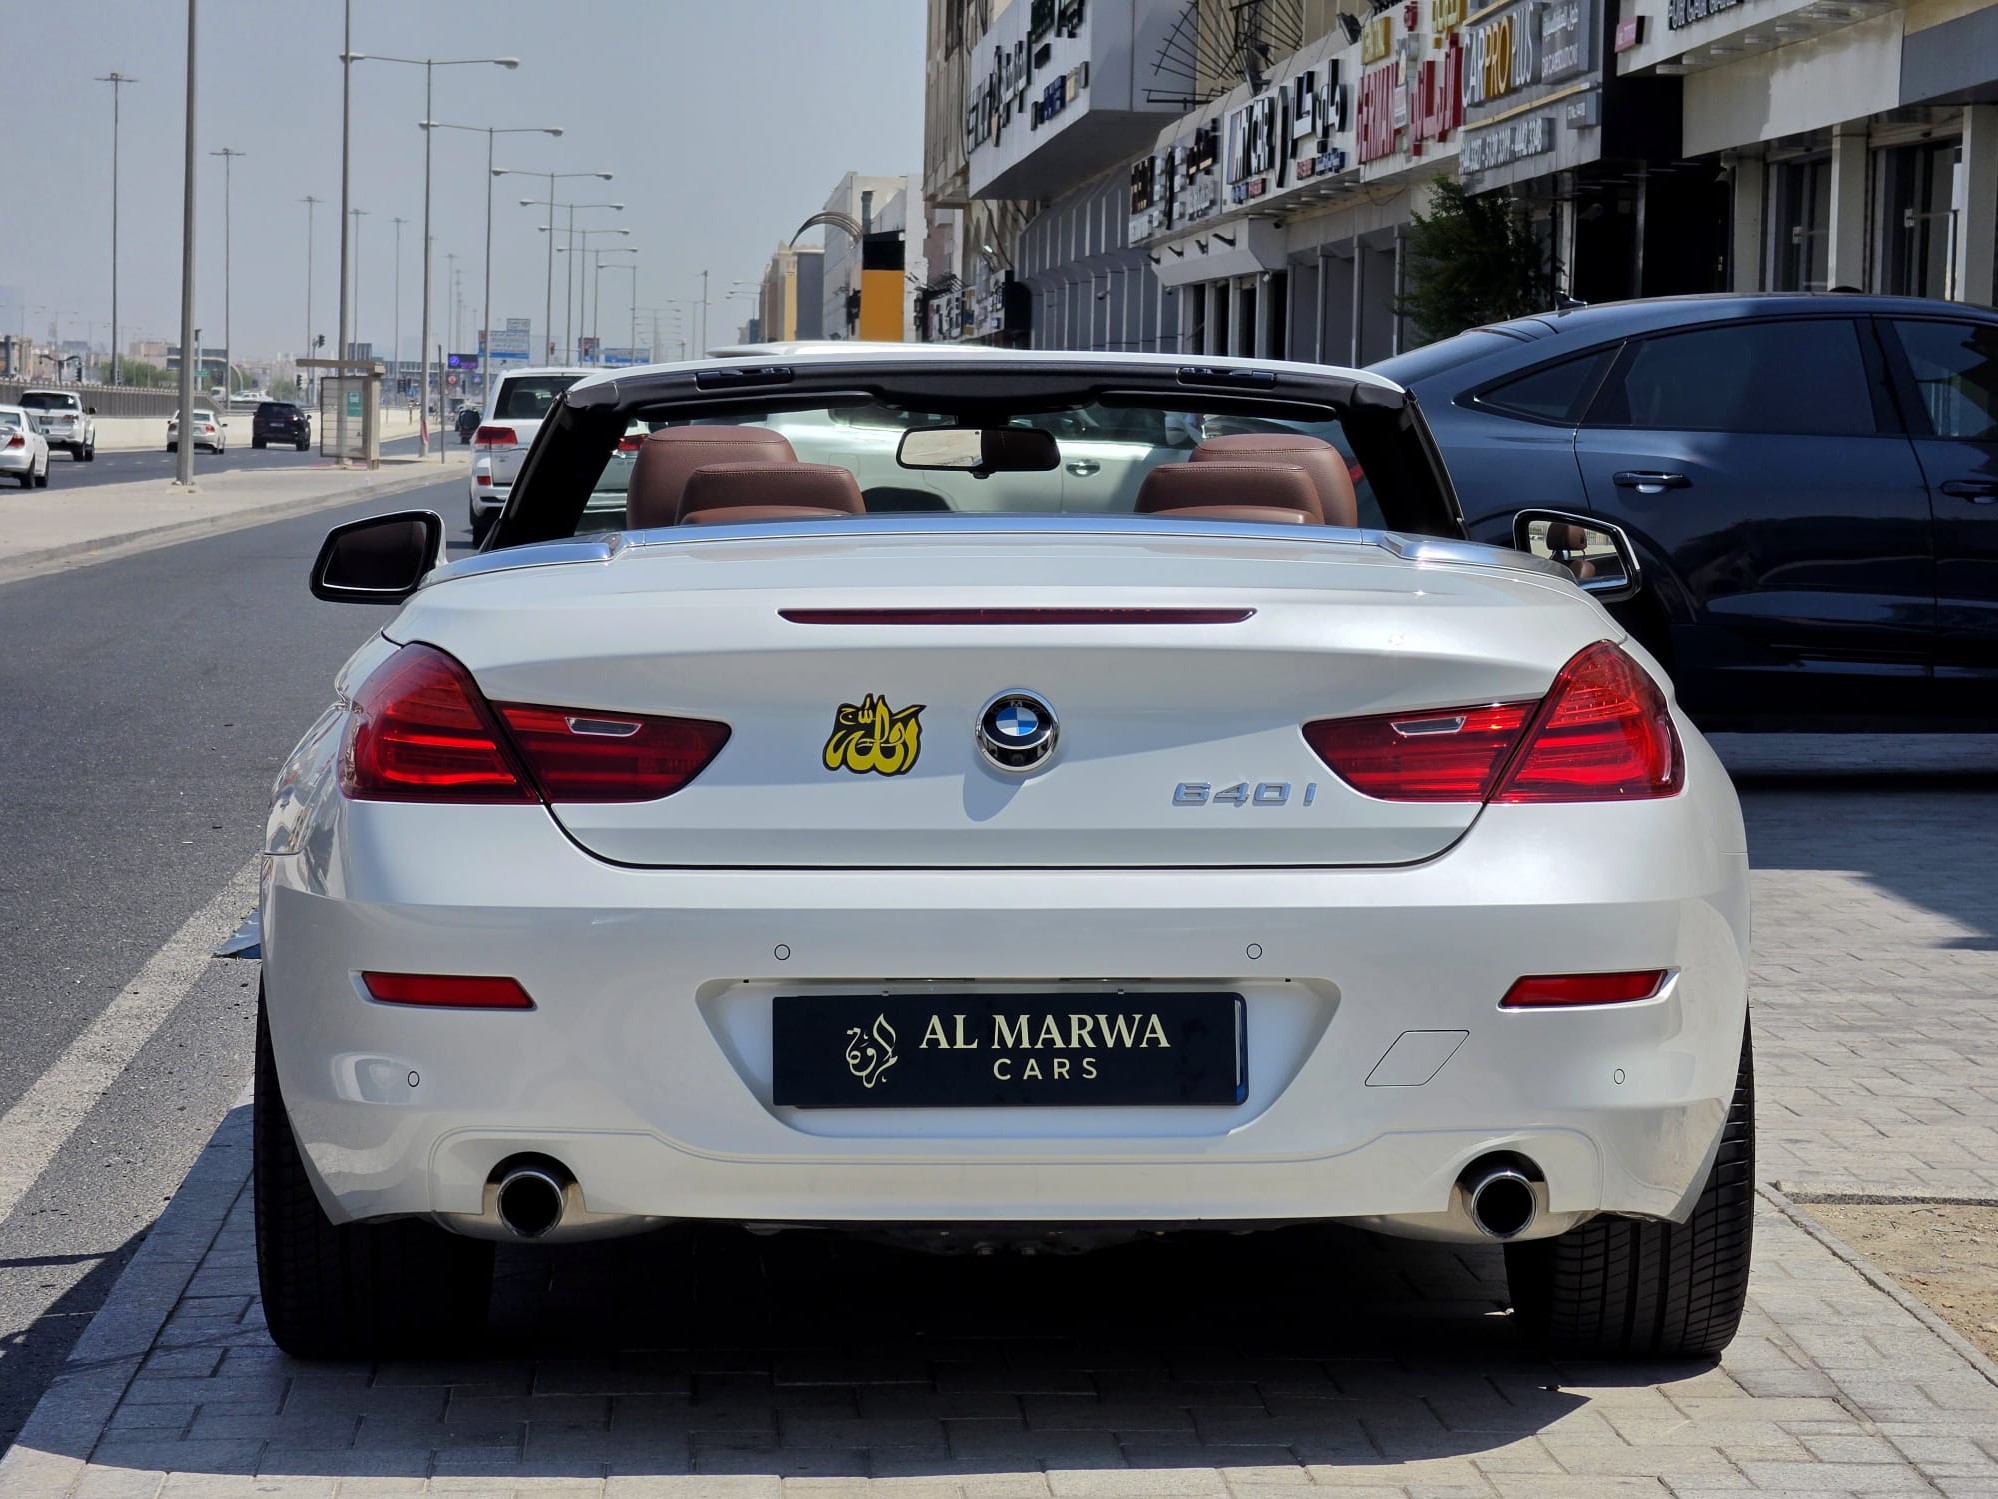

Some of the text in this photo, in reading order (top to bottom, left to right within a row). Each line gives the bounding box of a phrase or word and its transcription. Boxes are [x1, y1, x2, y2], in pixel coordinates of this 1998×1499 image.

[1511, 3, 1533, 88] PLUS
[1357, 62, 1399, 162] GERMAN
[919, 1013, 1171, 1049] AL MARWA
[993, 1057, 1098, 1081] CARS
